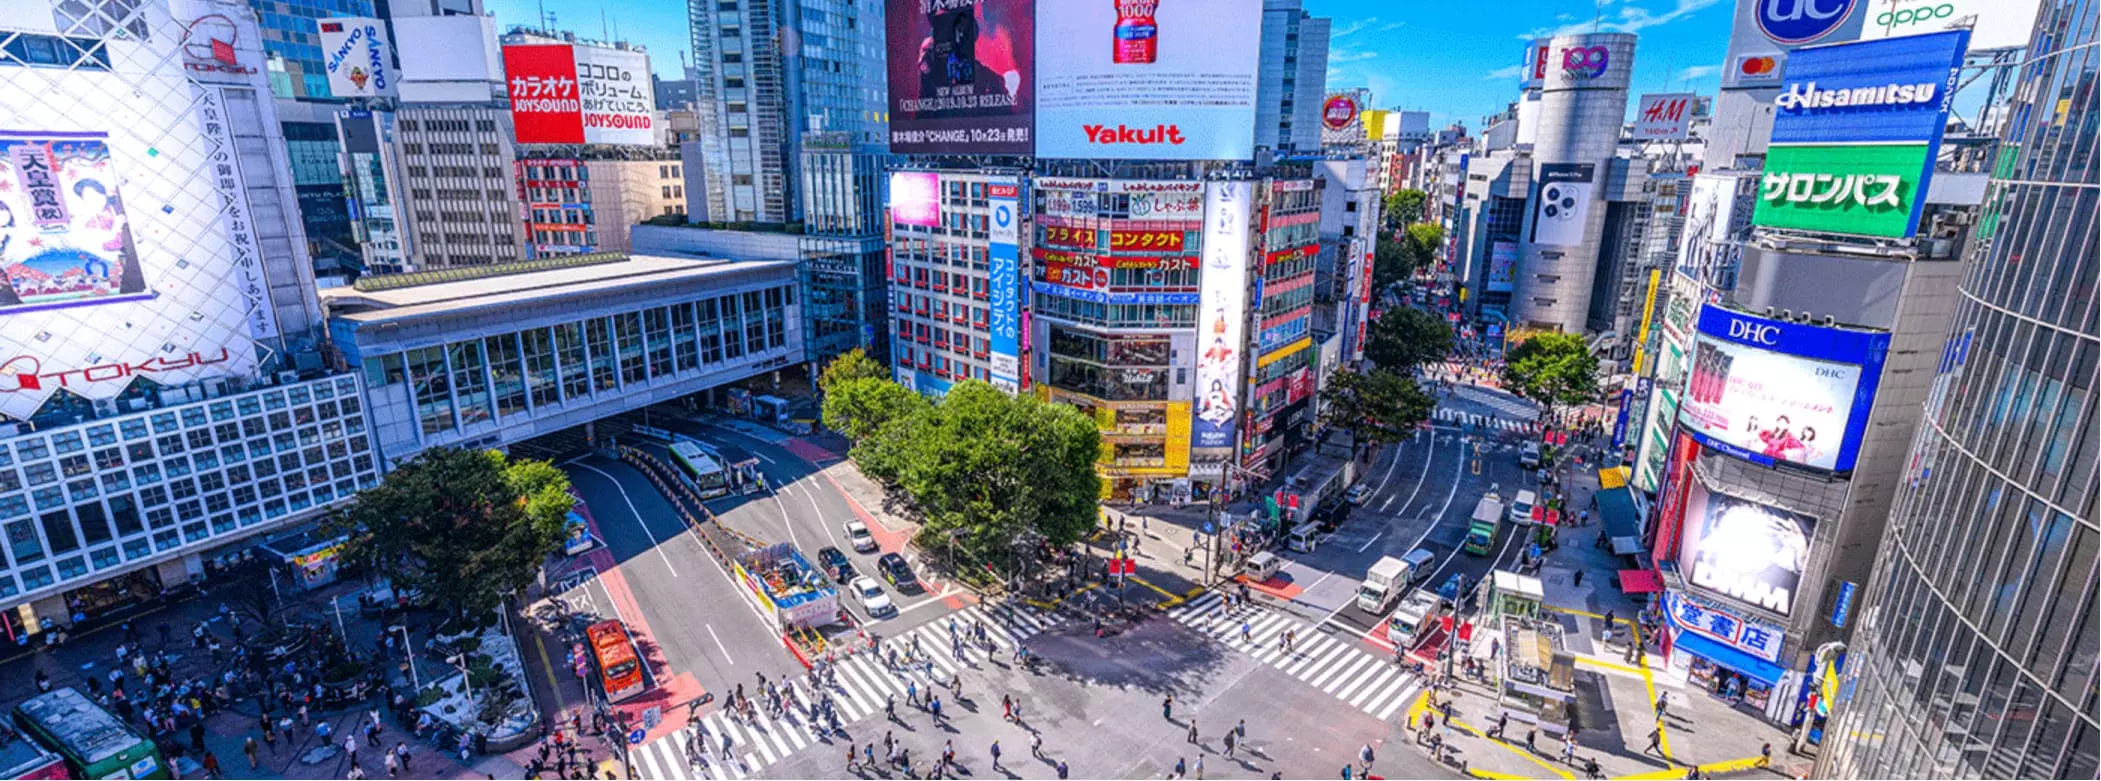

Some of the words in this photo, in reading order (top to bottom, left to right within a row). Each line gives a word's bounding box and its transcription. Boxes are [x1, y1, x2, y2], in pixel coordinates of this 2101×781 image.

[1119, 5, 1153, 18] 1000
[1876, 4, 1954, 28] oppo
[328, 28, 362, 73] SANKYO
[364, 24, 386, 90] SANKYO
[578, 62, 632, 82] ココロの
[1561, 45, 1609, 79] 109
[511, 76, 574, 97] カラオケ
[1775, 81, 1936, 110] Hisamitsu
[515, 98, 579, 113] JOYSOUND
[1643, 98, 1688, 123] H&M
[584, 113, 651, 129] JOYSOUND
[1082, 124, 1186, 145] Yakult
[1123, 182, 1200, 192] しゃぶしゃぶバイキング
[1763, 171, 1900, 207] サロンパス
[1111, 233, 1181, 247] コンタクト
[1159, 259, 1192, 270] ガスト
[1062, 268, 1091, 284] ガスト
[993, 257, 1005, 337] アイシティ
[1005, 258, 1015, 339] コンタクトの
[1728, 318, 1782, 345] DHC
[40, 347, 229, 387] TOKYU
[1815, 367, 1846, 380] DHC
